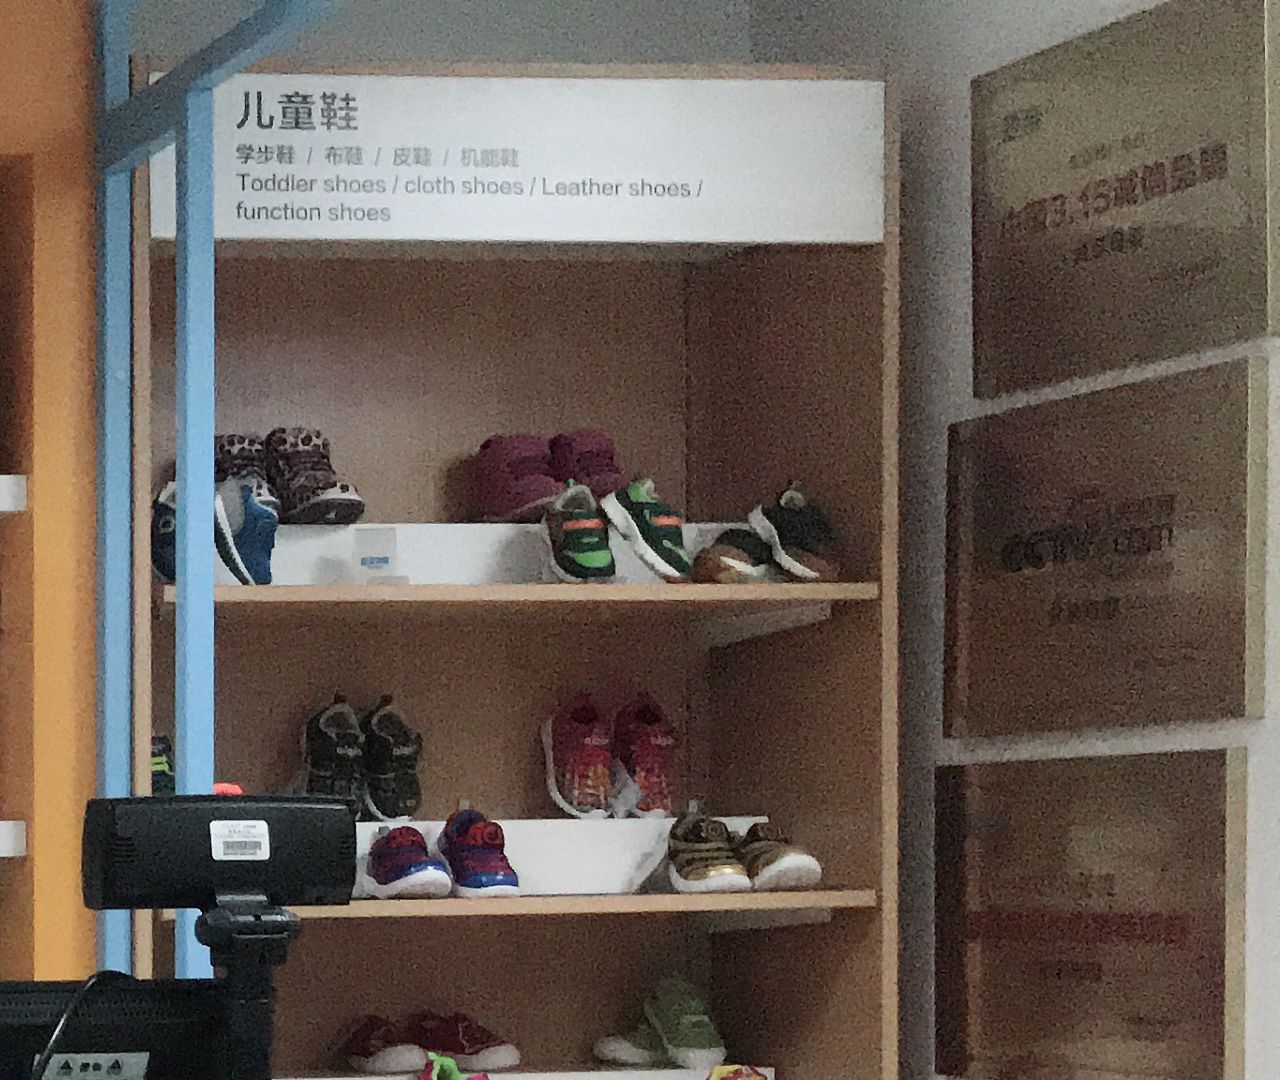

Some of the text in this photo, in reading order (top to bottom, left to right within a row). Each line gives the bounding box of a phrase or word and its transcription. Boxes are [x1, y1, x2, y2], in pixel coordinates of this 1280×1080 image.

[236, 91, 358, 131] 儿童鞋
[236, 144, 294, 165] 学步鞋
[239, 173, 317, 193] Toddler
[323, 175, 386, 193] shoes
[405, 175, 455, 194] cloth
[461, 177, 524, 196] shoes
[542, 177, 622, 196] Leather
[628, 178, 691, 197] shoes
[236, 201, 391, 221] function shoes
